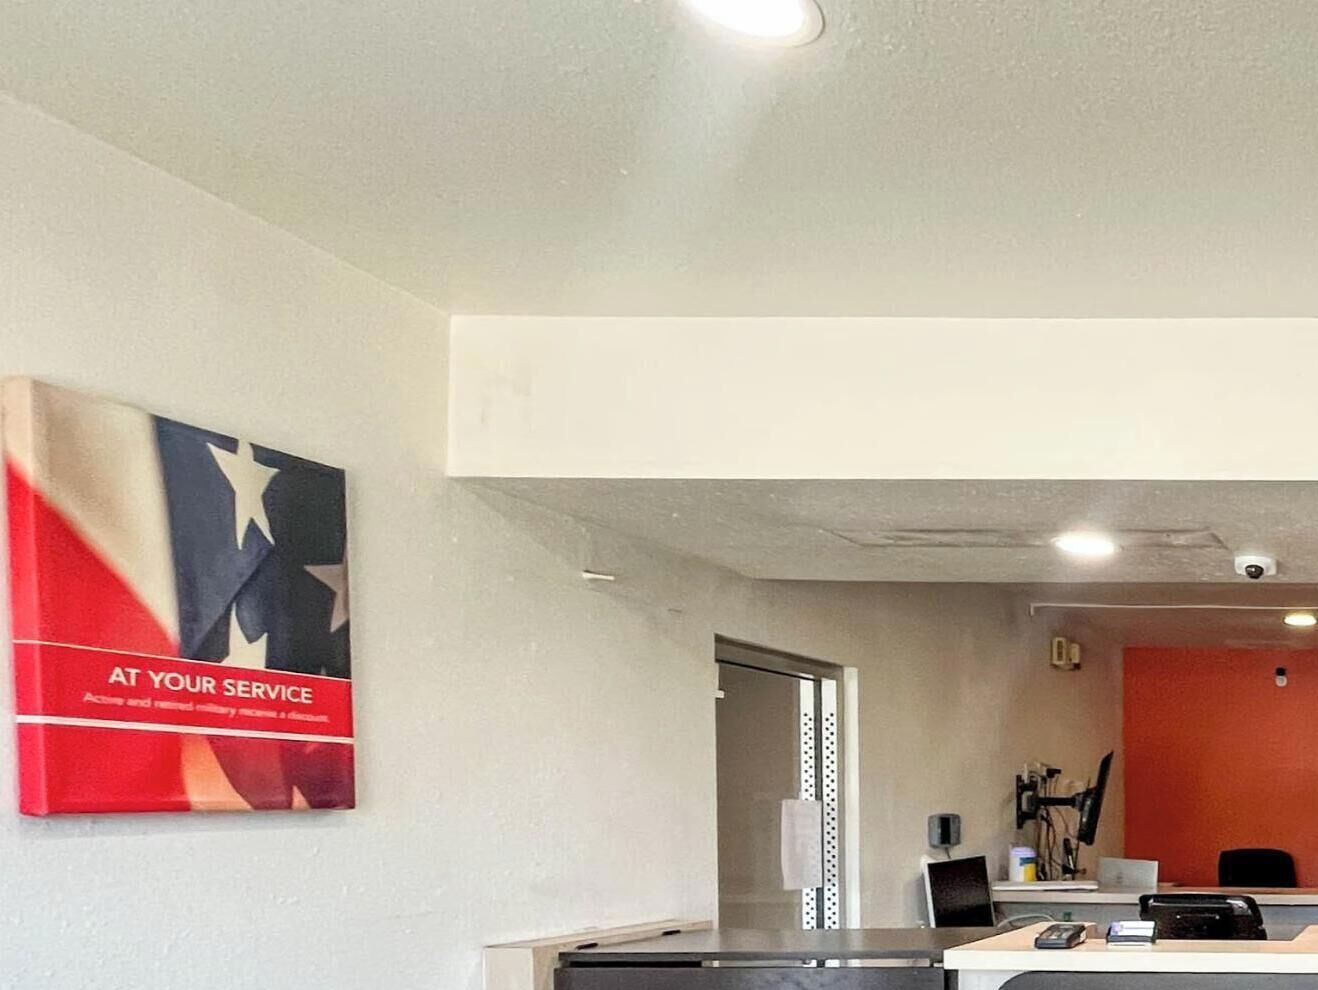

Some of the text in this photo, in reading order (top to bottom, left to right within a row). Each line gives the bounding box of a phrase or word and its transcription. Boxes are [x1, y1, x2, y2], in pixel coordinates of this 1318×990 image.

[108, 666, 313, 704] AT YOUR SERVICE
[126, 697, 152, 708] and
[154, 700, 194, 711] retired
[195, 702, 237, 718] military
[238, 708, 277, 718] receive
